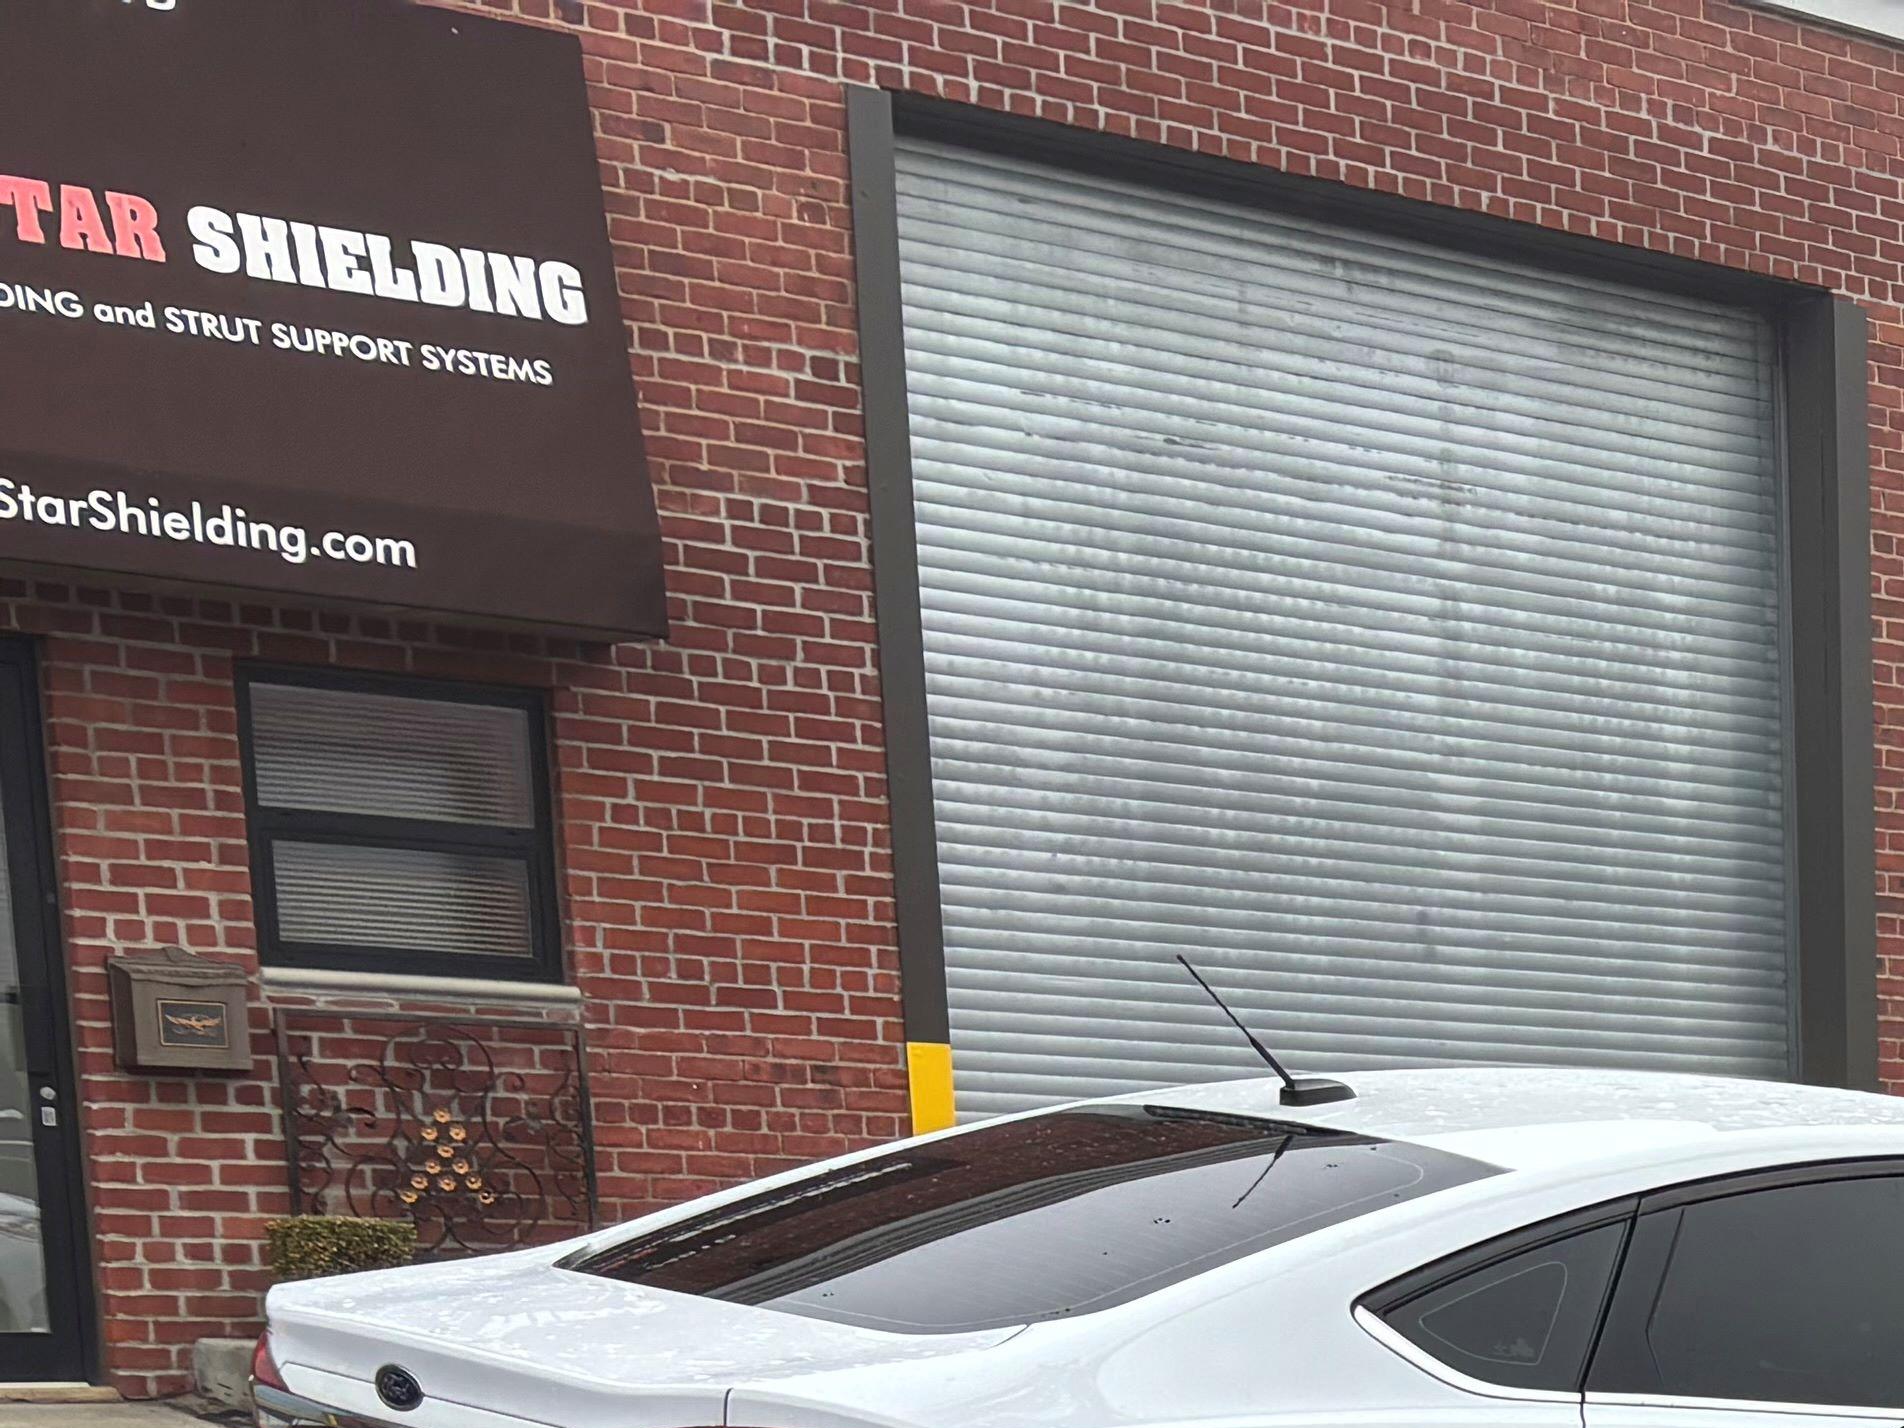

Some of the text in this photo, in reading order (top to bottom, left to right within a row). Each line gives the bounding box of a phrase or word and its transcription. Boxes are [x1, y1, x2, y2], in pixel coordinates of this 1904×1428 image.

[186, 205, 588, 325] SHIELDING
[93, 301, 156, 328] and
[163, 306, 262, 345] STRUT
[271, 322, 414, 367] SUPPORT
[420, 344, 553, 386] SYSTEMS
[0, 477, 417, 568] StarShielding.com
